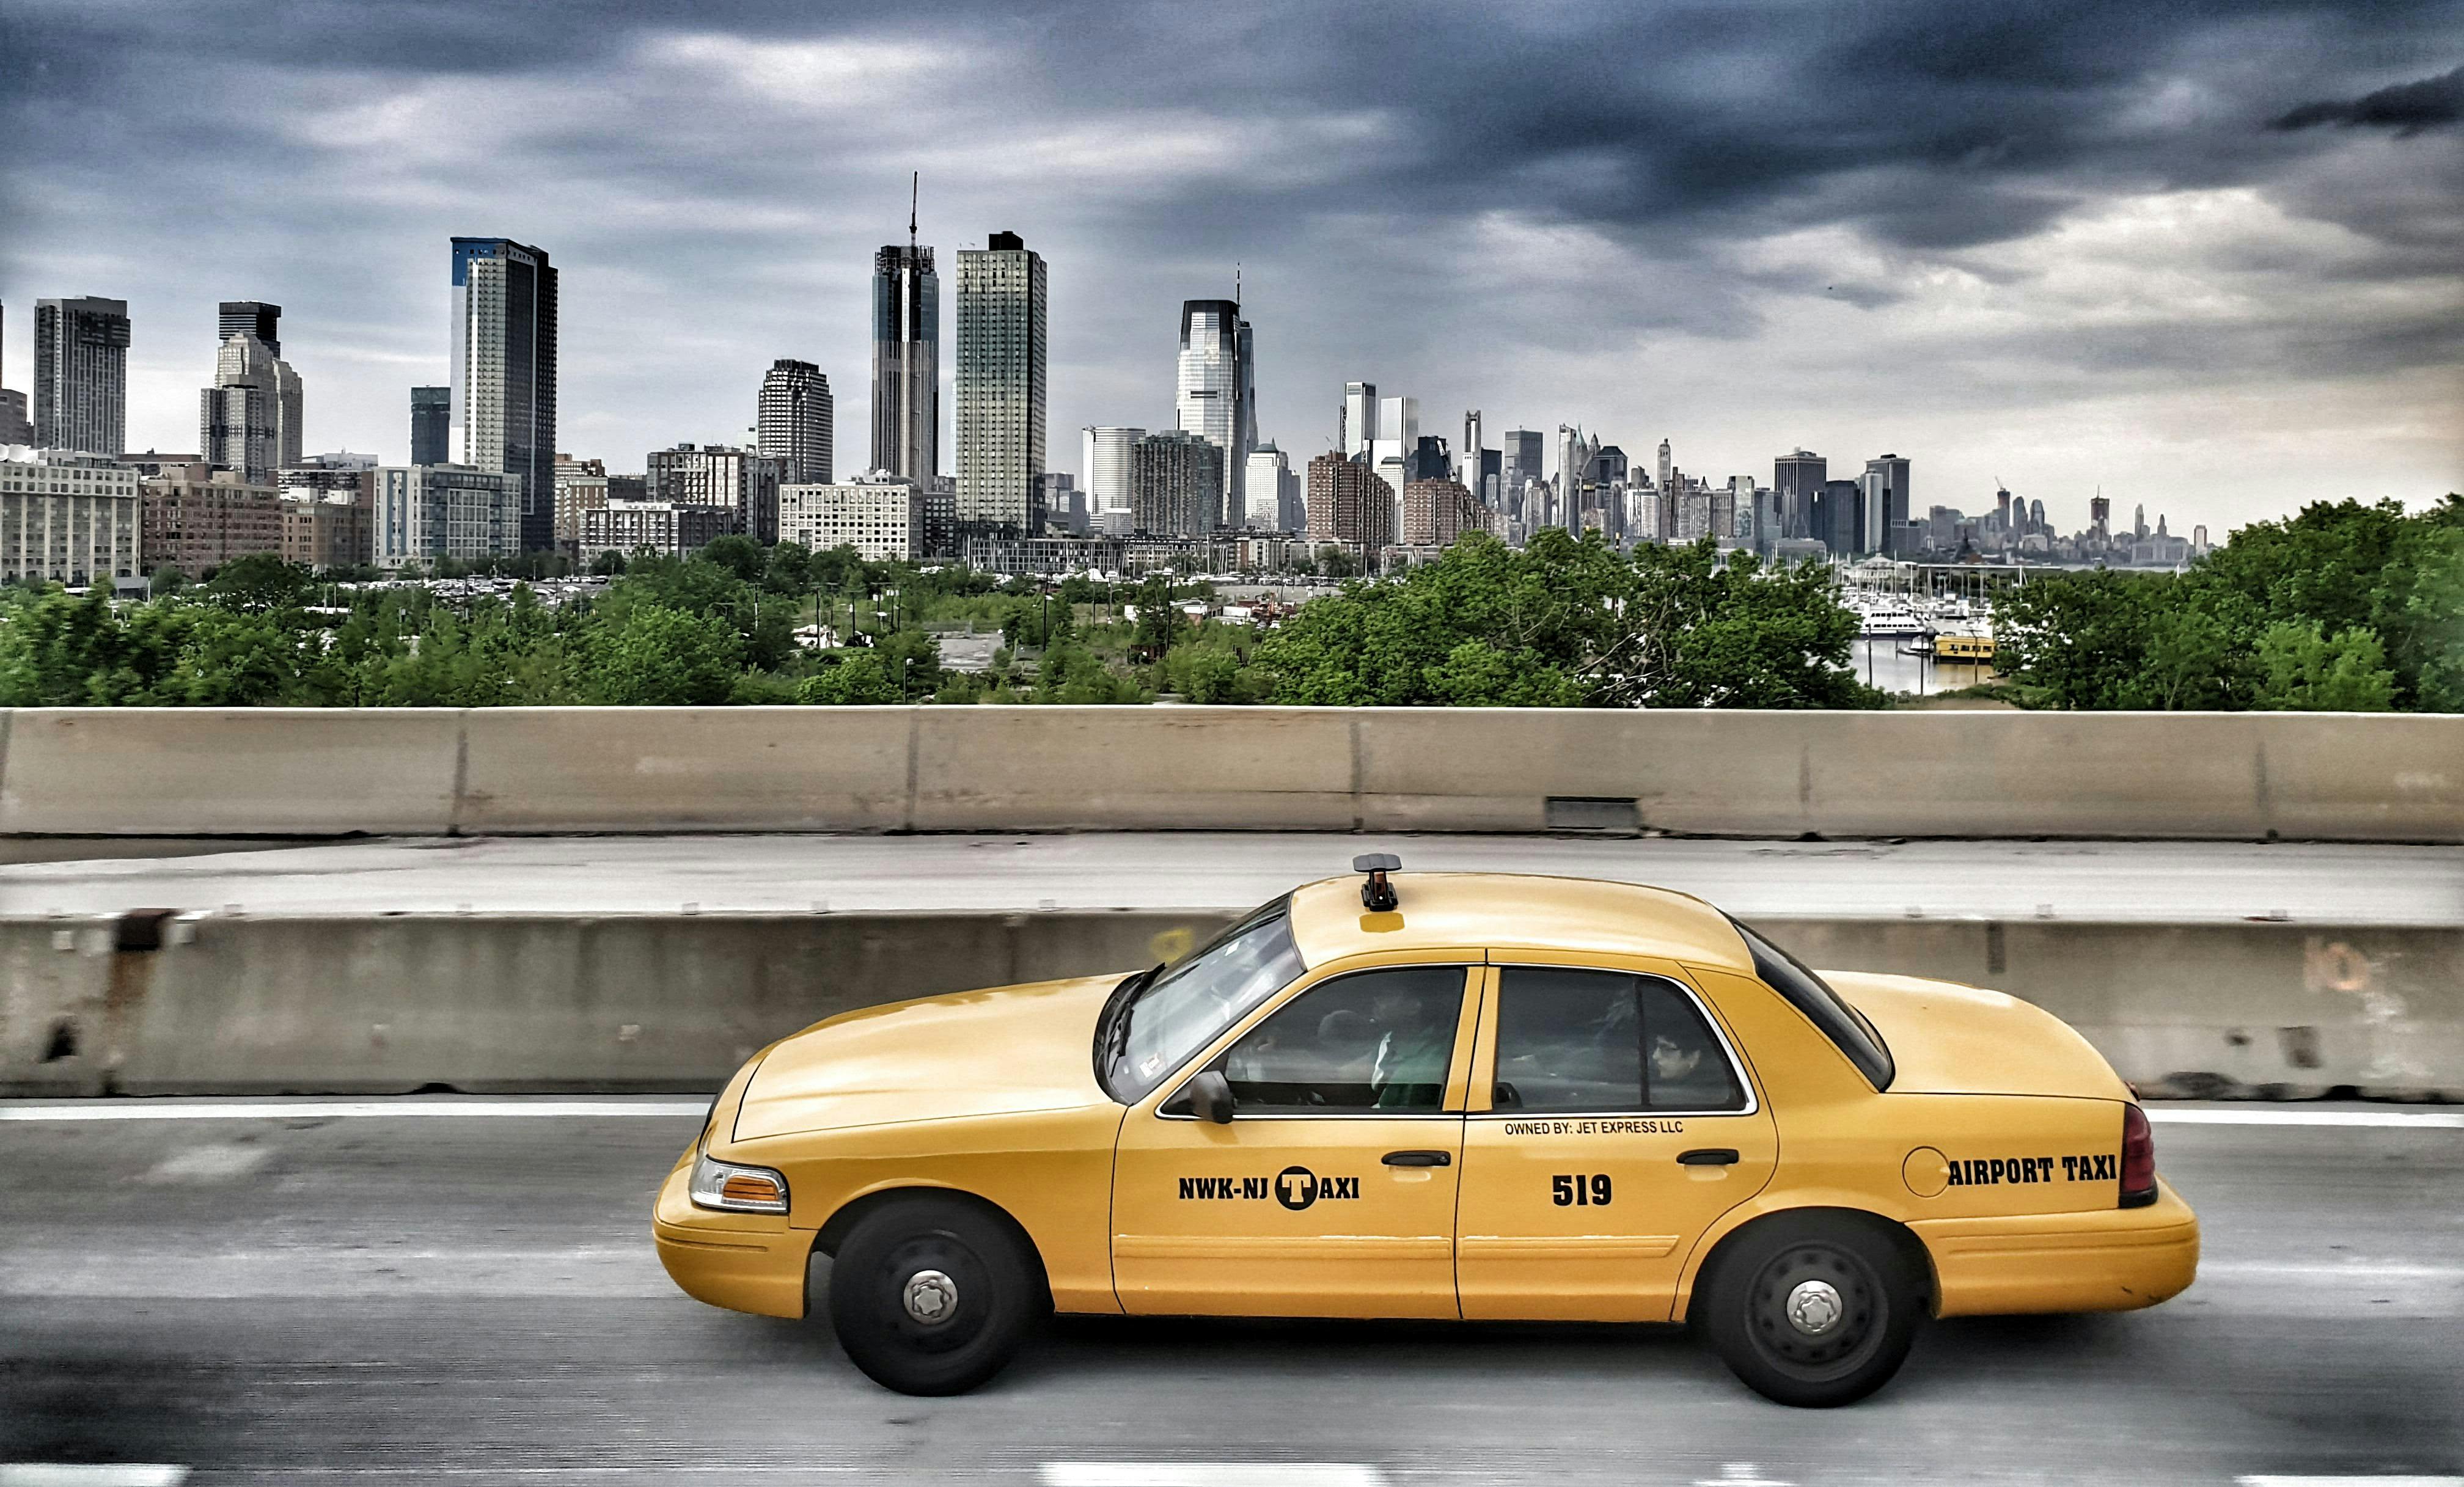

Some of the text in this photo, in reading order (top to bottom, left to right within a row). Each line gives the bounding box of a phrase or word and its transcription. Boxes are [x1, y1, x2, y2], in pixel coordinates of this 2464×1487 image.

[1505, 1120, 1684, 1135] OWNED BY: JET EXPRESS LLC
[1948, 1154, 2118, 1186] AIRPORT TAXI
[1178, 1172, 1360, 1203] NWK-NJ TAXI
[1552, 1174, 1612, 1207] 519
